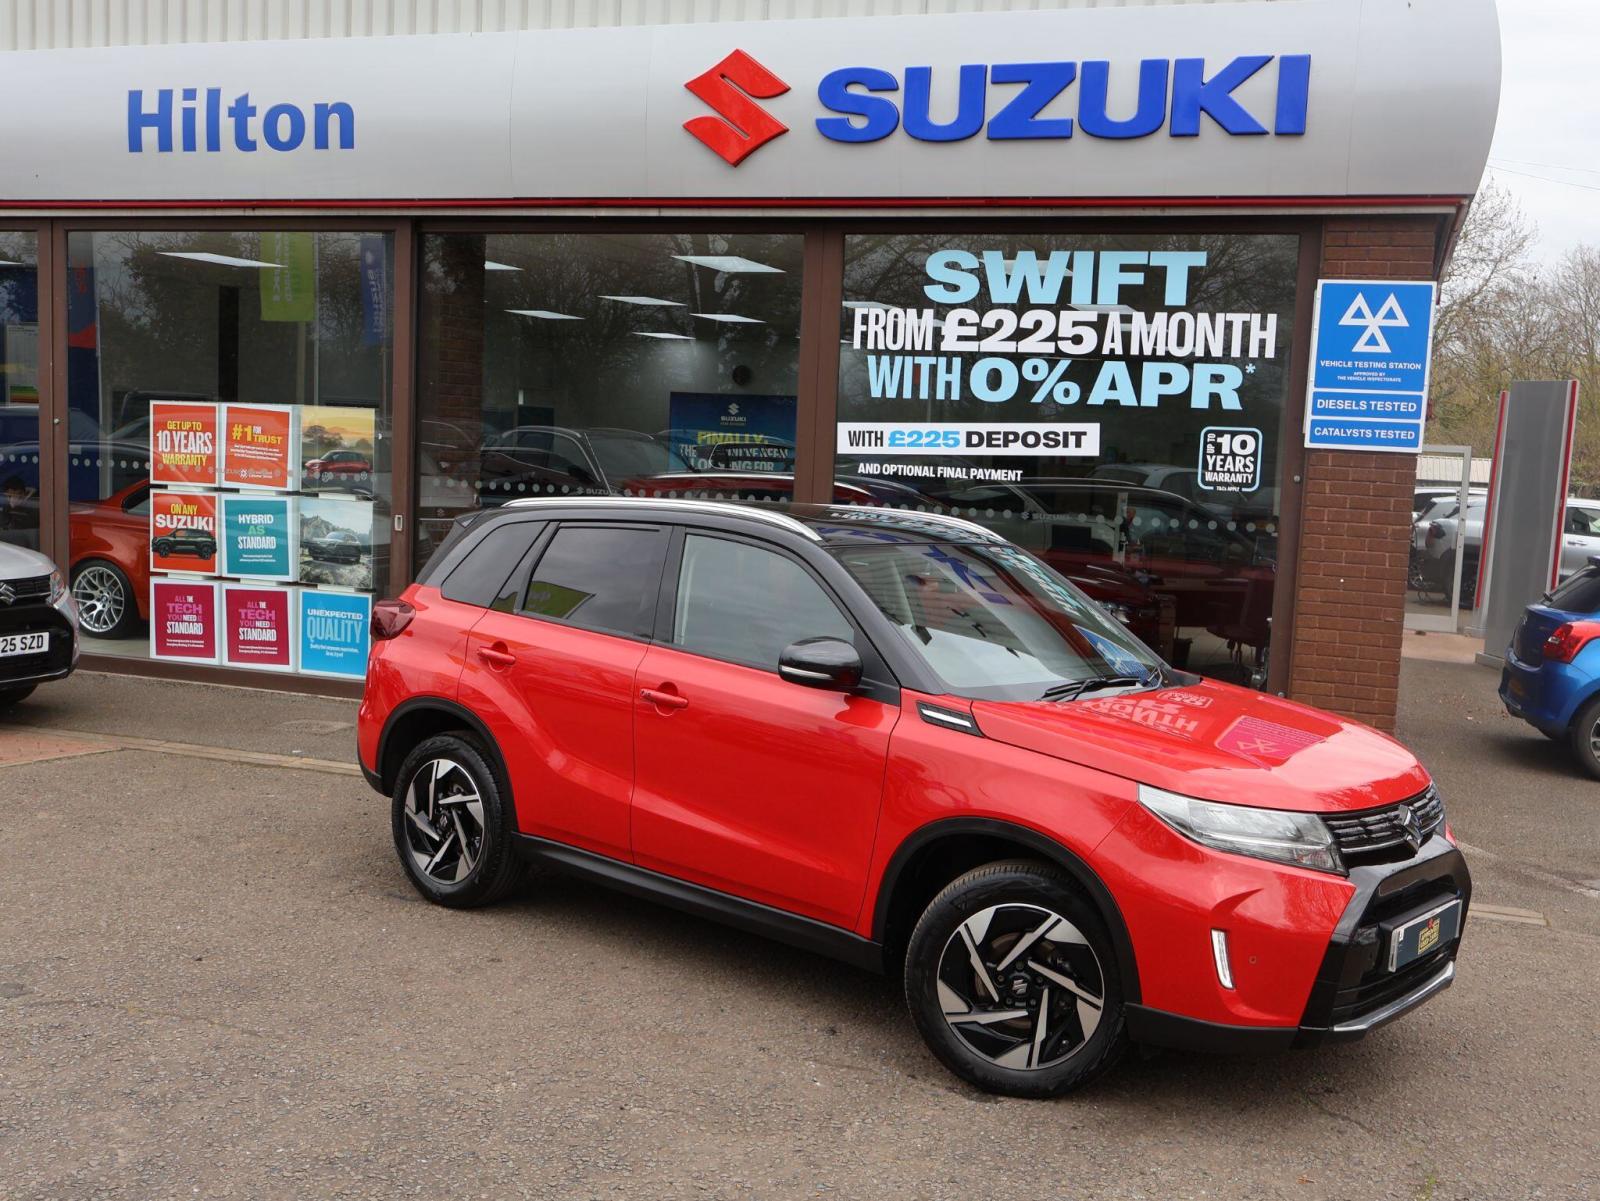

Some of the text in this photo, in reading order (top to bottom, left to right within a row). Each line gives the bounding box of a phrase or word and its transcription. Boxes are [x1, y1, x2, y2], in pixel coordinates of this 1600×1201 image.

[815, 54, 1311, 143] SUZUKI
[128, 88, 354, 153] Hilton
[924, 250, 1207, 306] SWIFT
[853, 308, 1277, 358] FROM £225 A MONTH
[1320, 360, 1421, 370] VEHICLE TESTING STATION
[867, 355, 961, 400] WITH
[969, 357, 1081, 405] 0%
[1317, 399, 1417, 412] DIESELS TESTED
[167, 420, 202, 431] GET UP TO
[232, 423, 252, 442] #1
[253, 434, 283, 445] TRUST
[848, 430, 1087, 449] WITH £225 DEPOSIT
[1314, 427, 1415, 440] CATALYSTS TESTED
[156, 429, 171, 453] 10
[172, 430, 213, 455] YEARS
[1206, 433, 1216, 454] UP TO
[1217, 434, 1256, 456] 10
[162, 453, 208, 467] WARRANTY
[1206, 455, 1255, 473] YEARS
[858, 463, 1023, 482] AND OPTIONAL FINAL PAYMENT
[1205, 472, 1253, 484] WARRANTY
[170, 503, 198, 516] ON ANY
[155, 513, 214, 531] SUZUKI
[238, 514, 274, 525] HYBRID
[248, 525, 266, 535] AS
[237, 536, 277, 550] STANDARD
[175, 595, 186, 603] ALL
[247, 601, 259, 609] ALL
[166, 602, 203, 614] TECH
[238, 608, 276, 621] TECH
[307, 608, 363, 620] UNEXPECTED
[167, 613, 182, 621] YOU
[182, 614, 197, 622] NEED
[240, 620, 255, 628] YOU
[255, 620, 270, 628] NEED
[166, 621, 204, 636] STANDARD
[238, 627, 277, 642] STANDARD
[306, 616, 363, 644] QUALITY
[1, 635, 44, 653] 25 SZD
